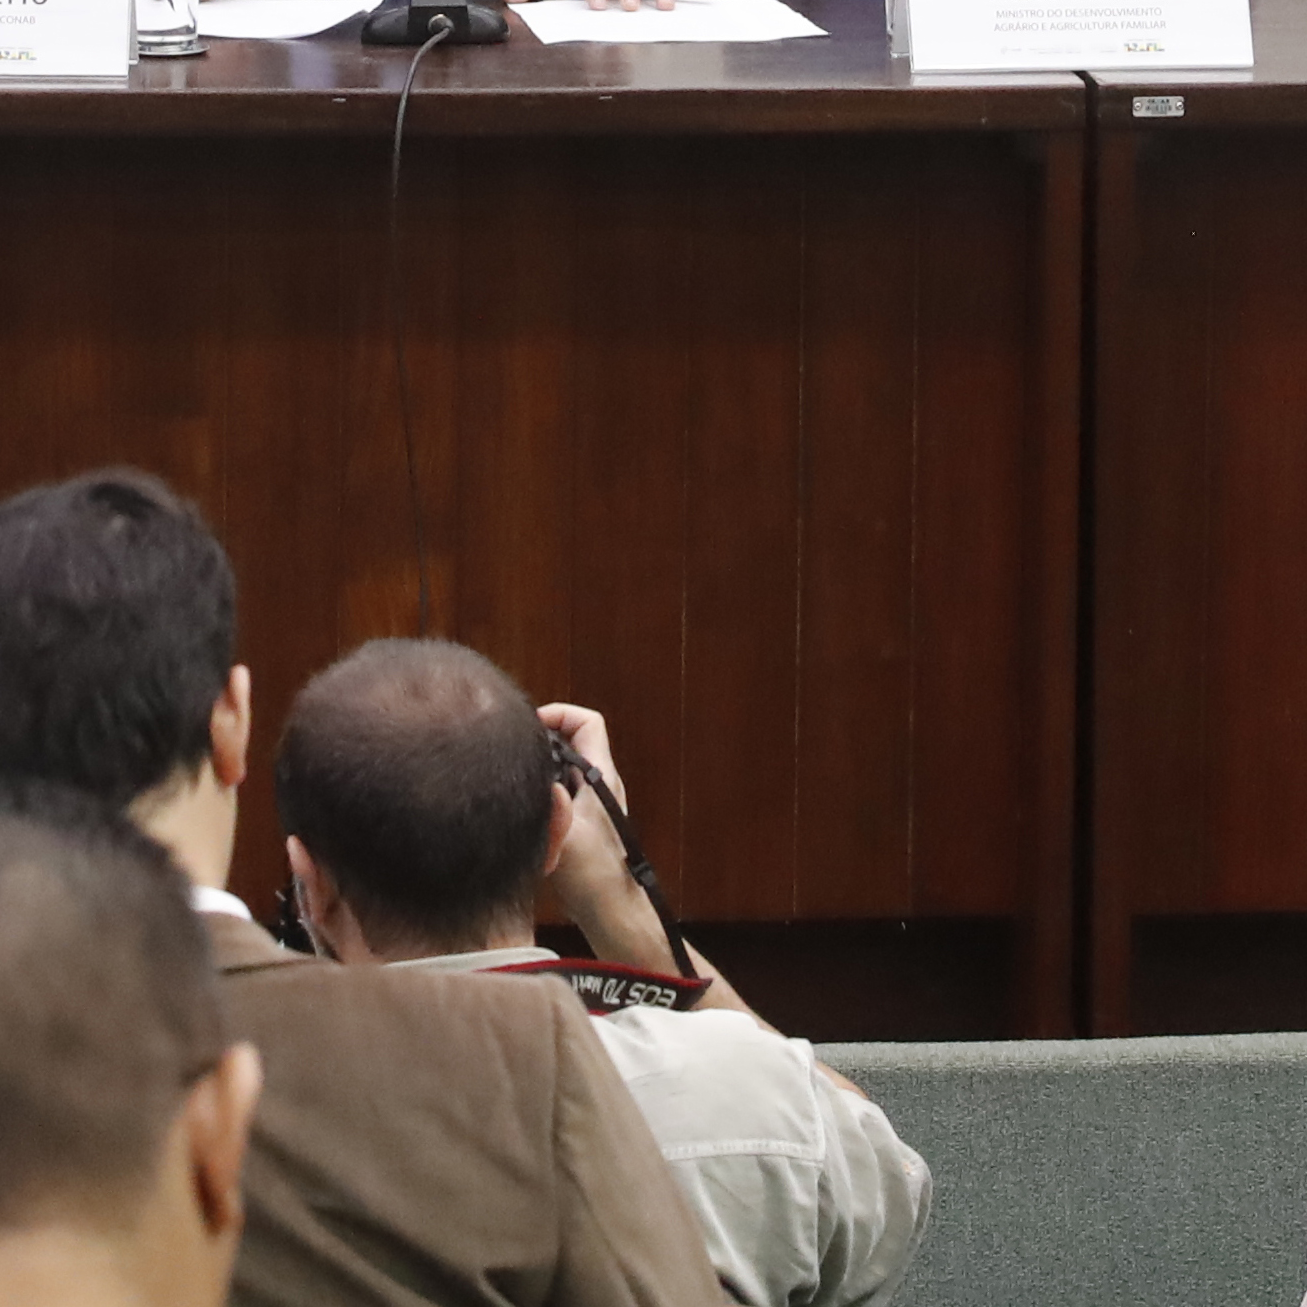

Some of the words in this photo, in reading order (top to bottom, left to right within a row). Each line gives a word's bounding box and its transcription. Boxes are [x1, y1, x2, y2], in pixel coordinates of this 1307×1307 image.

[995, 8, 1045, 19] MINISTRO
[1046, 8, 1063, 18] DO
[1065, 7, 1163, 18] DESENVOLVIMENTO
[0, 15, 37, 25] CONAB
[993, 21, 1040, 32] AGRÁRIO
[1041, 22, 1047, 31] E
[1049, 21, 1119, 32] AGRICULTURA
[1120, 20, 1167, 30] FAMILIAR
[602, 978, 627, 1005] 7D
[625, 982, 677, 1008] EOS
